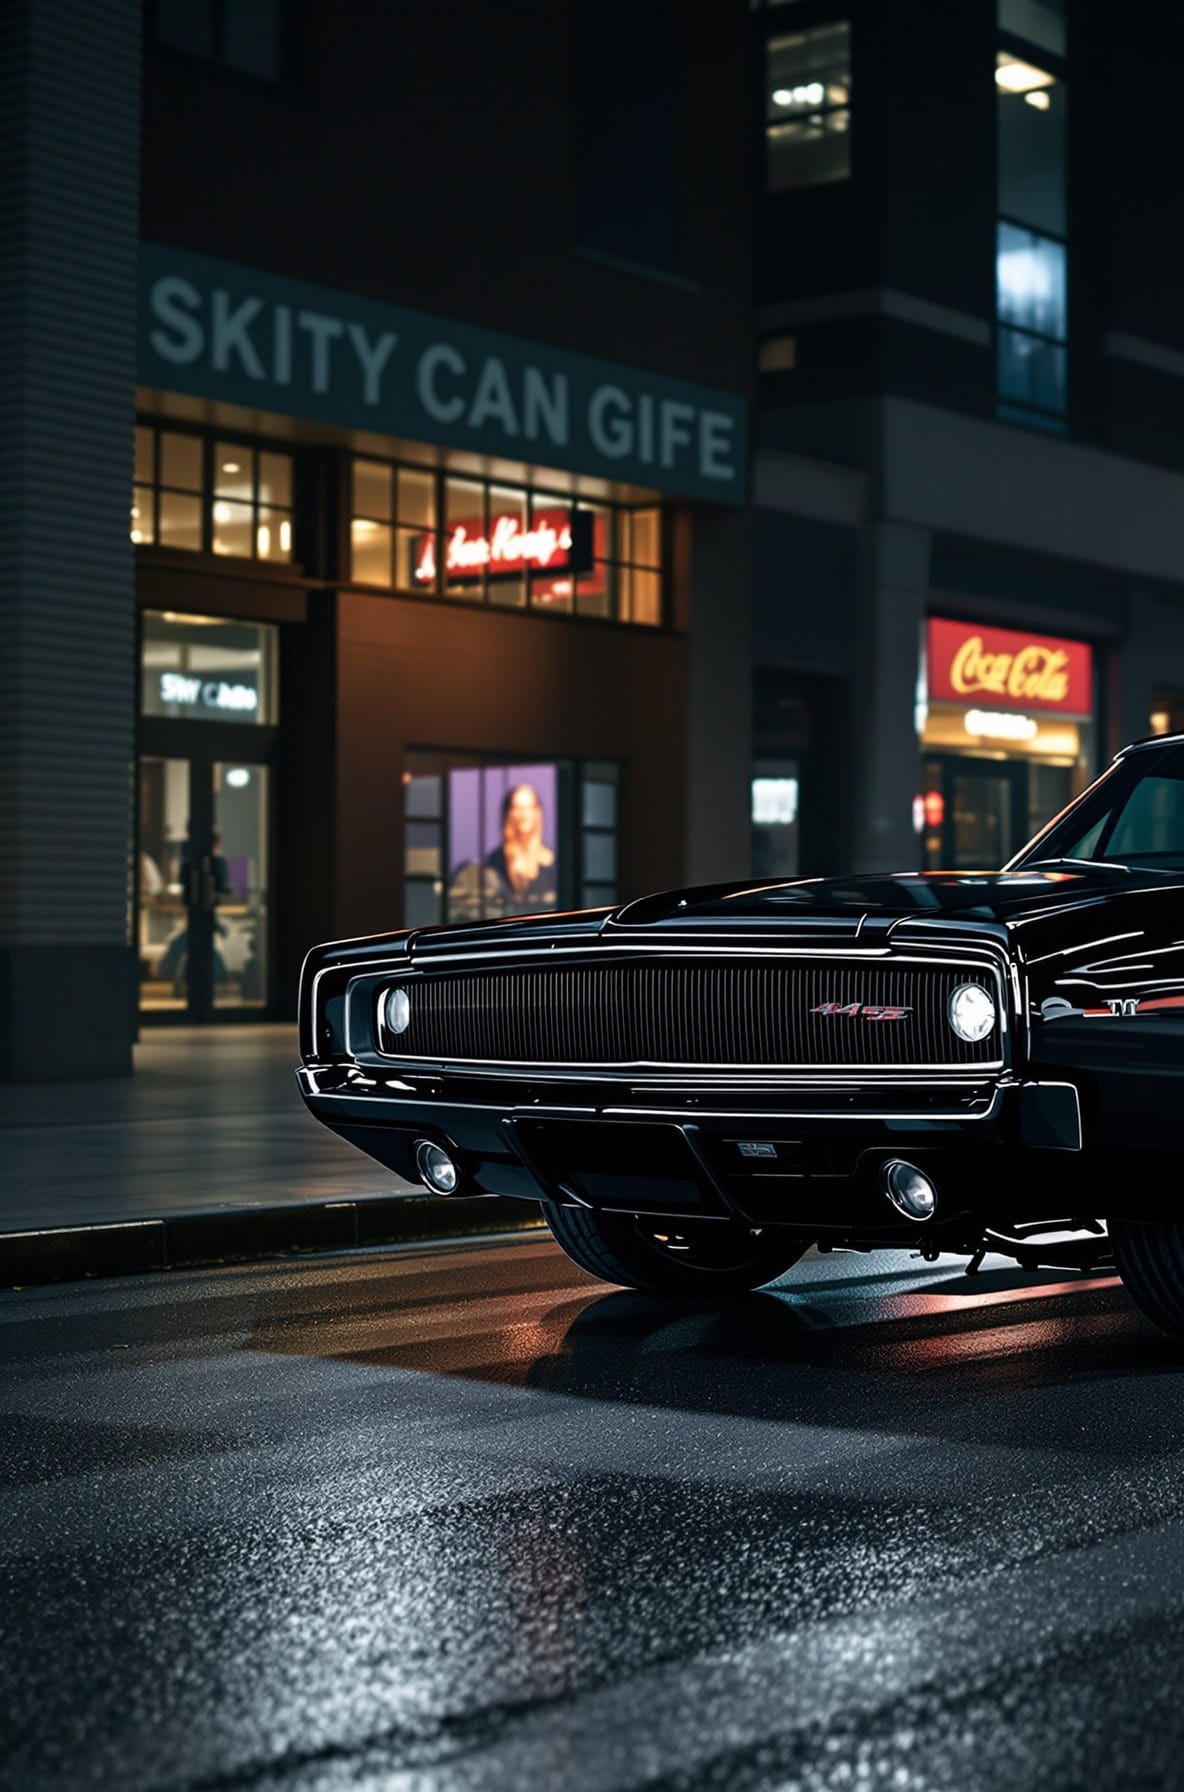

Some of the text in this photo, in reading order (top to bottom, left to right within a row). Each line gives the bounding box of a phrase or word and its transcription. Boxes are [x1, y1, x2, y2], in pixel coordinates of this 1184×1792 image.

[149, 276, 736, 481] SKITY CAN GIFE
